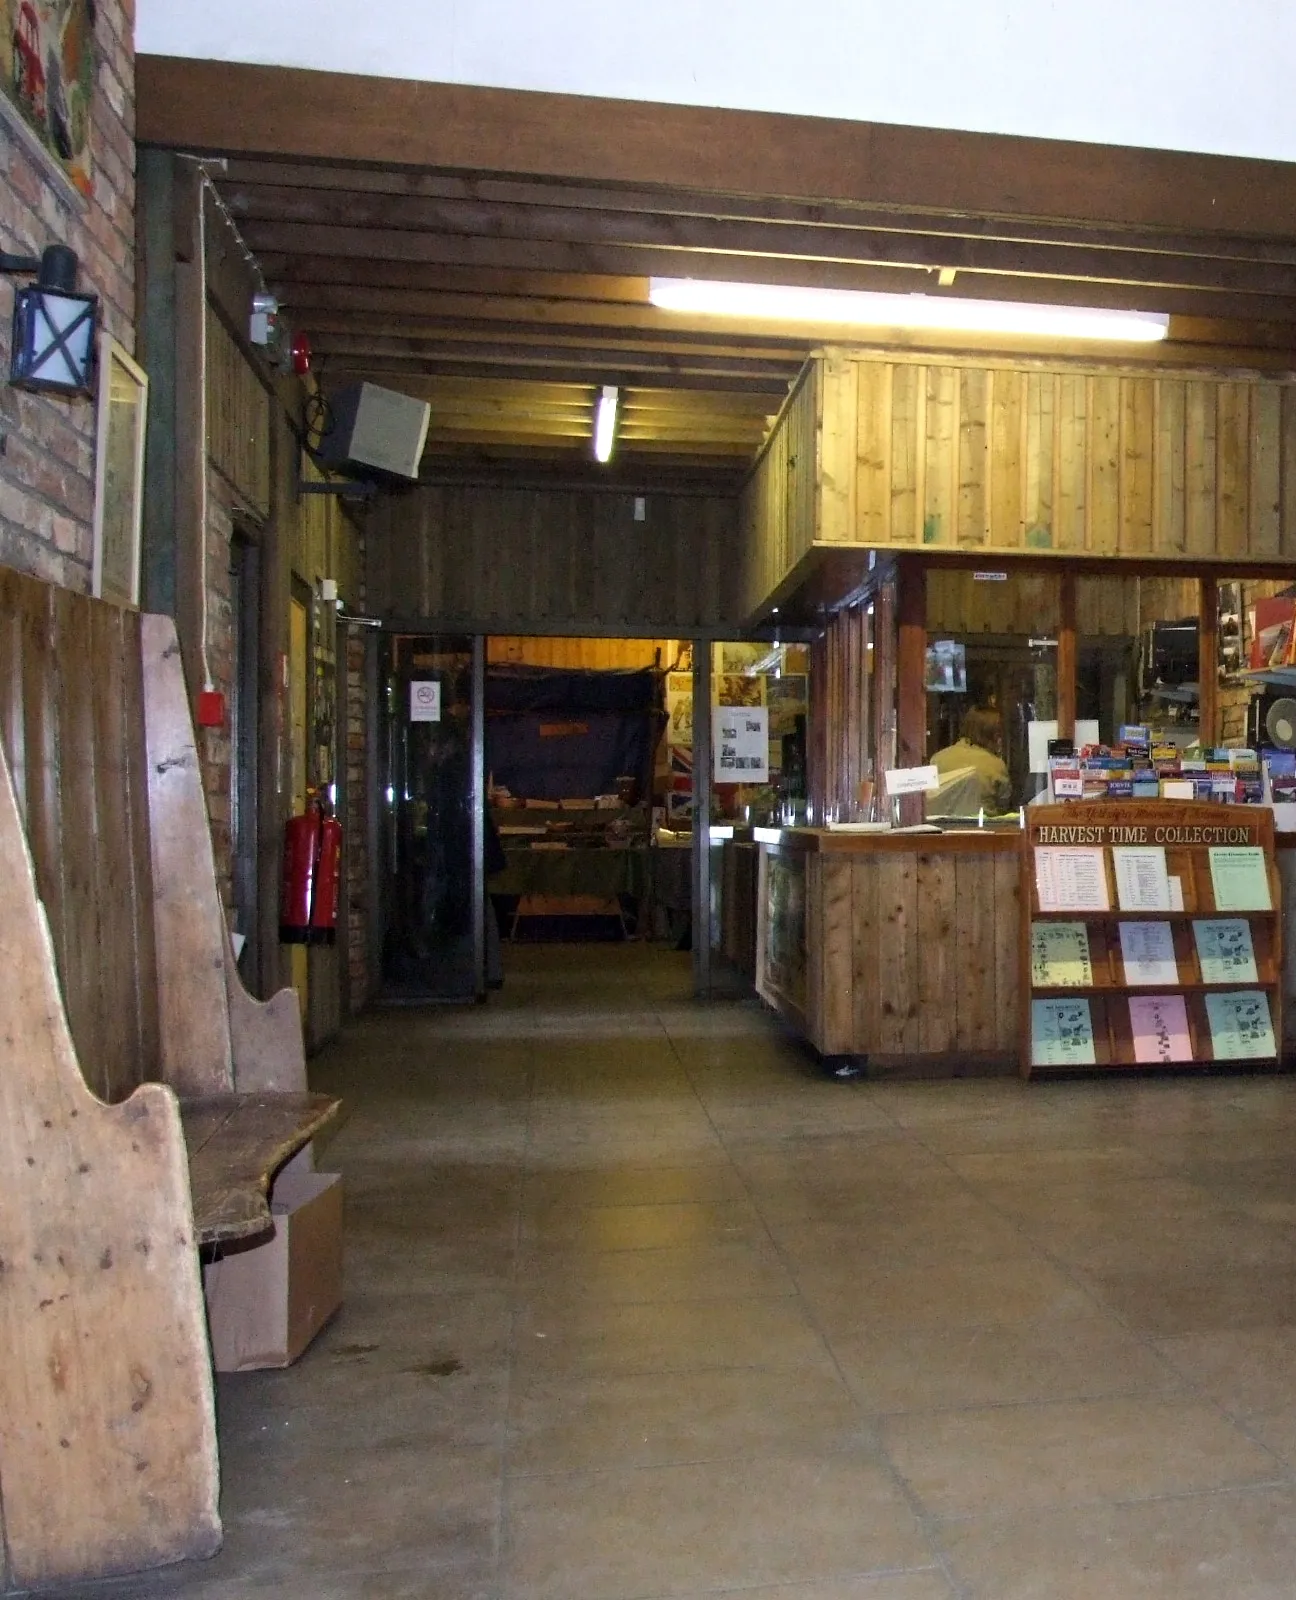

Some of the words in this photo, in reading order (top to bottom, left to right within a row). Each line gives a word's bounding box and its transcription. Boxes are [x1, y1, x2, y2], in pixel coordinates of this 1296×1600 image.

[1039, 826, 1105, 843] HARVEST
[1108, 826, 1148, 843] TIME
[1155, 826, 1250, 844] COLLECTION
